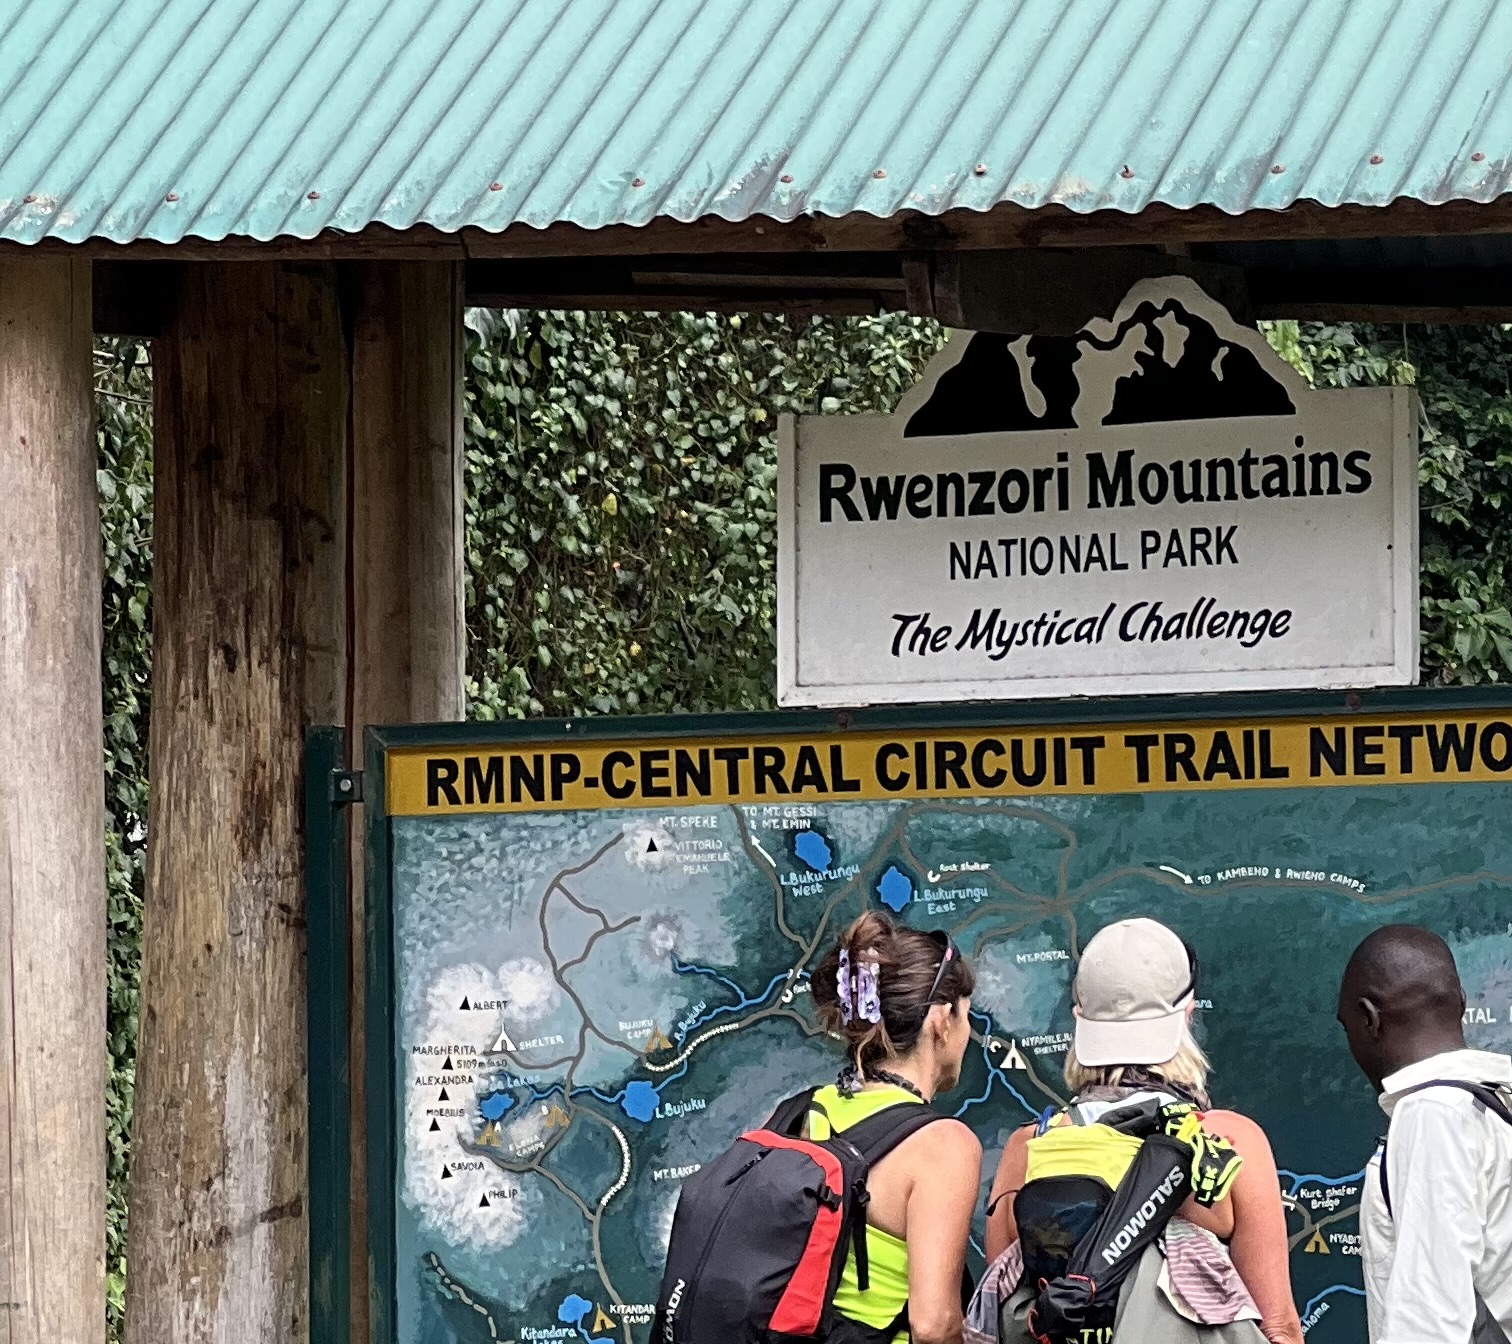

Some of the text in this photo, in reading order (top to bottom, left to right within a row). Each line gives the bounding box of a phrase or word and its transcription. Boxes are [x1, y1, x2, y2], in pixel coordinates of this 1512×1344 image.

[819, 435, 1373, 522] Rwenzori Mountains
[949, 525, 1240, 580] NATIONAL PARK
[891, 596, 1292, 661] The Mystical Challenge
[427, 744, 861, 807] RMNP-CENTRAL
[876, 735, 1105, 792] CIRCUIT
[1124, 728, 1290, 784] TRAIL
[683, 864, 709, 875] PEAK
[1198, 874, 1212, 885] TO
[1330, 872, 1366, 893] CAMPS
[792, 883, 823, 898] West
[927, 902, 957, 915] East
[473, 1000, 508, 1011] ALBERT
[412, 1045, 477, 1056] MARGHERITA
[415, 1075, 474, 1087] ALEXANDRA
[1101, 1165, 1185, 1266] SALOMON
[623, 1315, 651, 1324] CAMP
[520, 1325, 578, 1340] Kitandara
